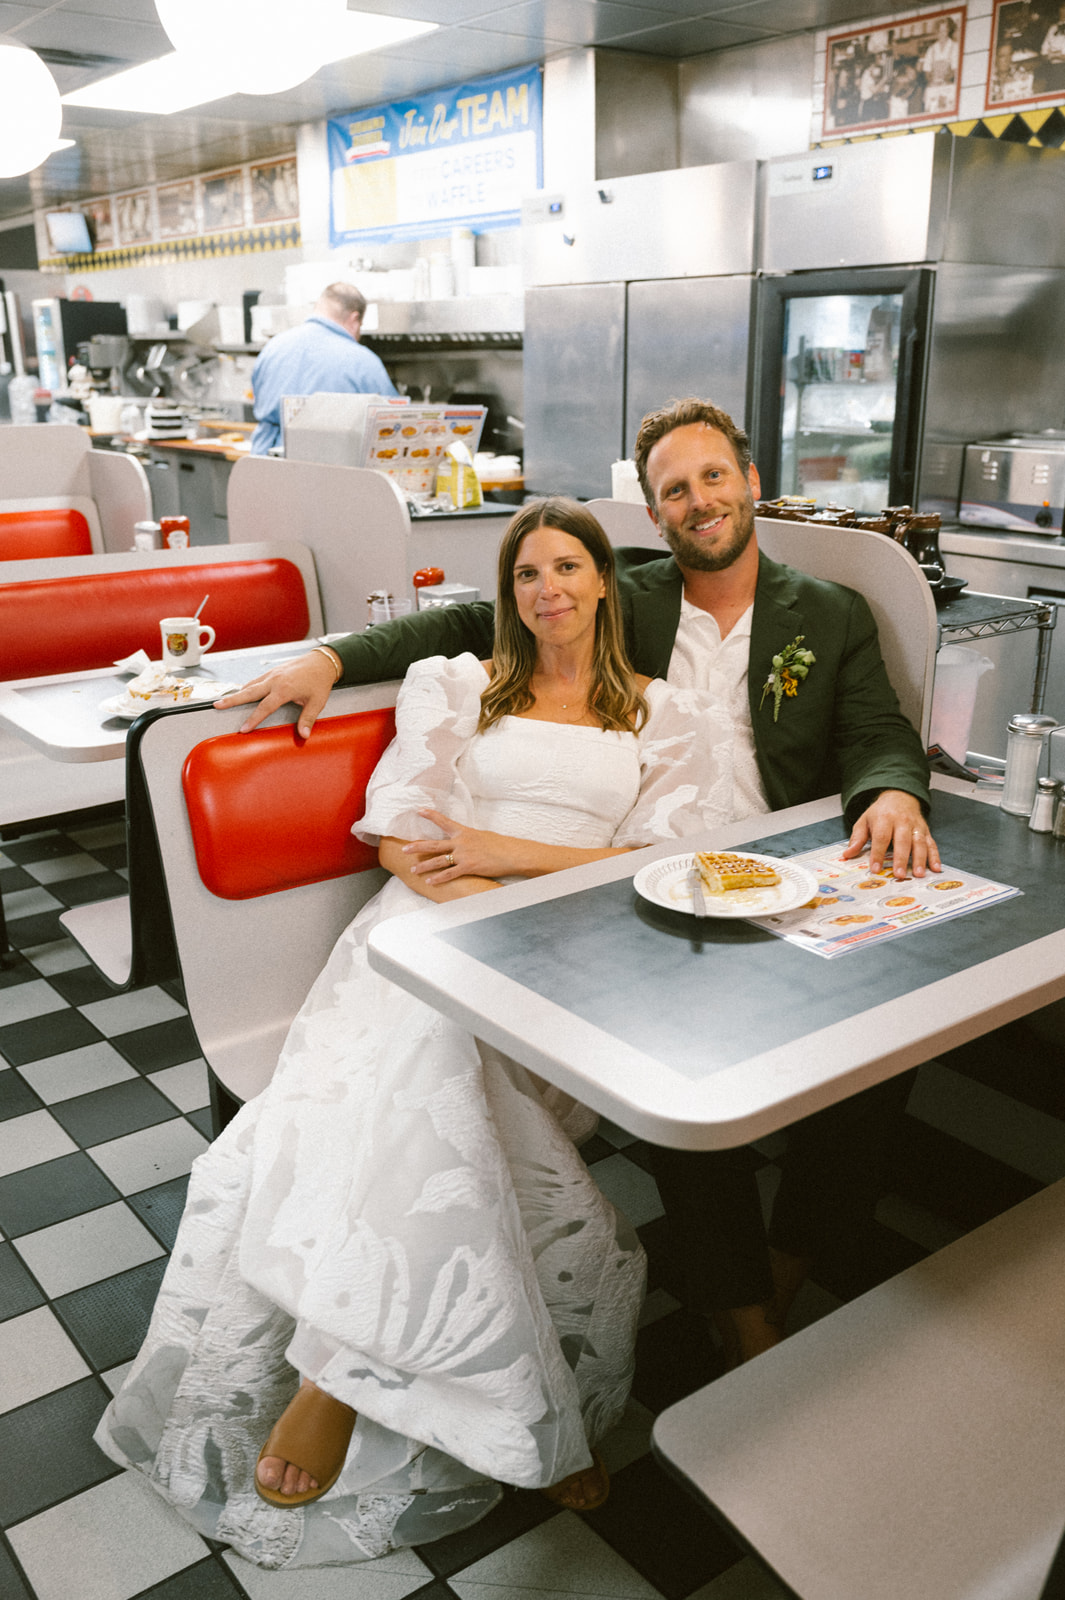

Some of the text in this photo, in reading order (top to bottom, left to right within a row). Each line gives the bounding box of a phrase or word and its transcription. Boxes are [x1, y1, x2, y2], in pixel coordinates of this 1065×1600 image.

[398, 109, 428, 149] Join
[456, 83, 529, 137] TEAM
[441, 147, 516, 179] CAREERS
